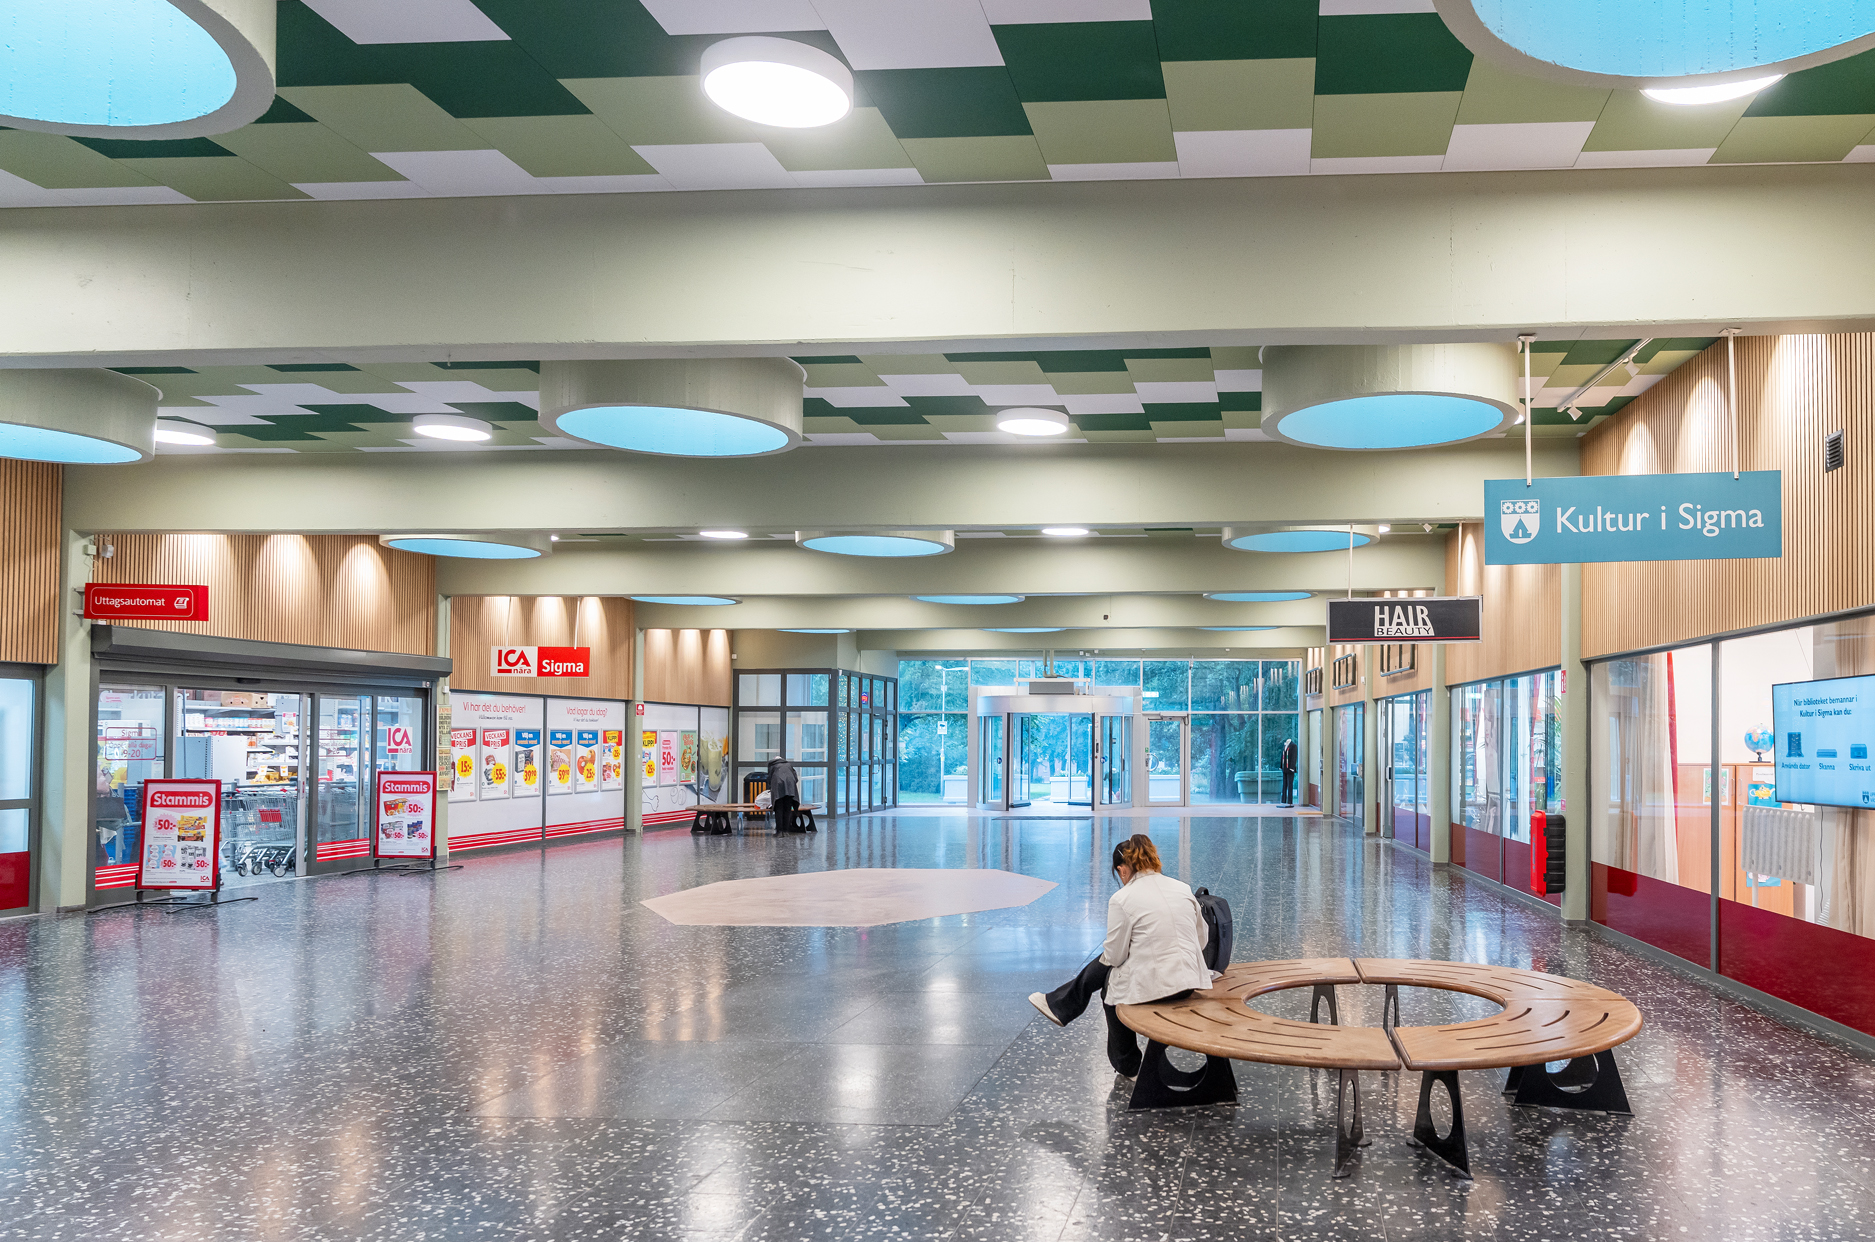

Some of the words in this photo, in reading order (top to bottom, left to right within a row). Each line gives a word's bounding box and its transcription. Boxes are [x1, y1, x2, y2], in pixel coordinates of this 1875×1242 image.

[1556, 505, 1649, 533] Kultur
[1661, 505, 1666, 530] i
[1678, 503, 1764, 537] Sigma
[94, 596, 166, 608] Uttagsautomat
[1374, 605, 1432, 626] HAIR
[1376, 627, 1432, 636] BEAUTY
[497, 649, 531, 667] ICA
[513, 666, 532, 674] nära
[541, 659, 584, 675] Sigma
[1803, 697, 1828, 706] biblioteket
[1829, 696, 1854, 705] bemannar
[470, 702, 481, 712] har
[481, 703, 492, 712] det
[492, 703, 500, 713] du
[501, 703, 526, 714] behöver!
[566, 706, 576, 715] Vad
[576, 707, 588, 717] lagar
[589, 707, 595, 716] du
[596, 708, 608, 718] idag?
[1799, 709, 1814, 718] Kultur
[1817, 708, 1833, 718] Sigma
[387, 727, 412, 746] ICA
[485, 731, 506, 740] VECKANS
[399, 746, 413, 754] nära
[661, 751, 676, 766] 50:-
[460, 760, 472, 773] 15:-
[1849, 763, 1864, 771] Skriva
[495, 768, 507, 780] 55:-
[385, 782, 428, 792] Stammis
[153, 793, 209, 806] Stammis
[408, 803, 424, 813] 50:-
[157, 819, 177, 830] 50:-
[162, 859, 177, 868] 50:-
[195, 859, 210, 868] 50:-
